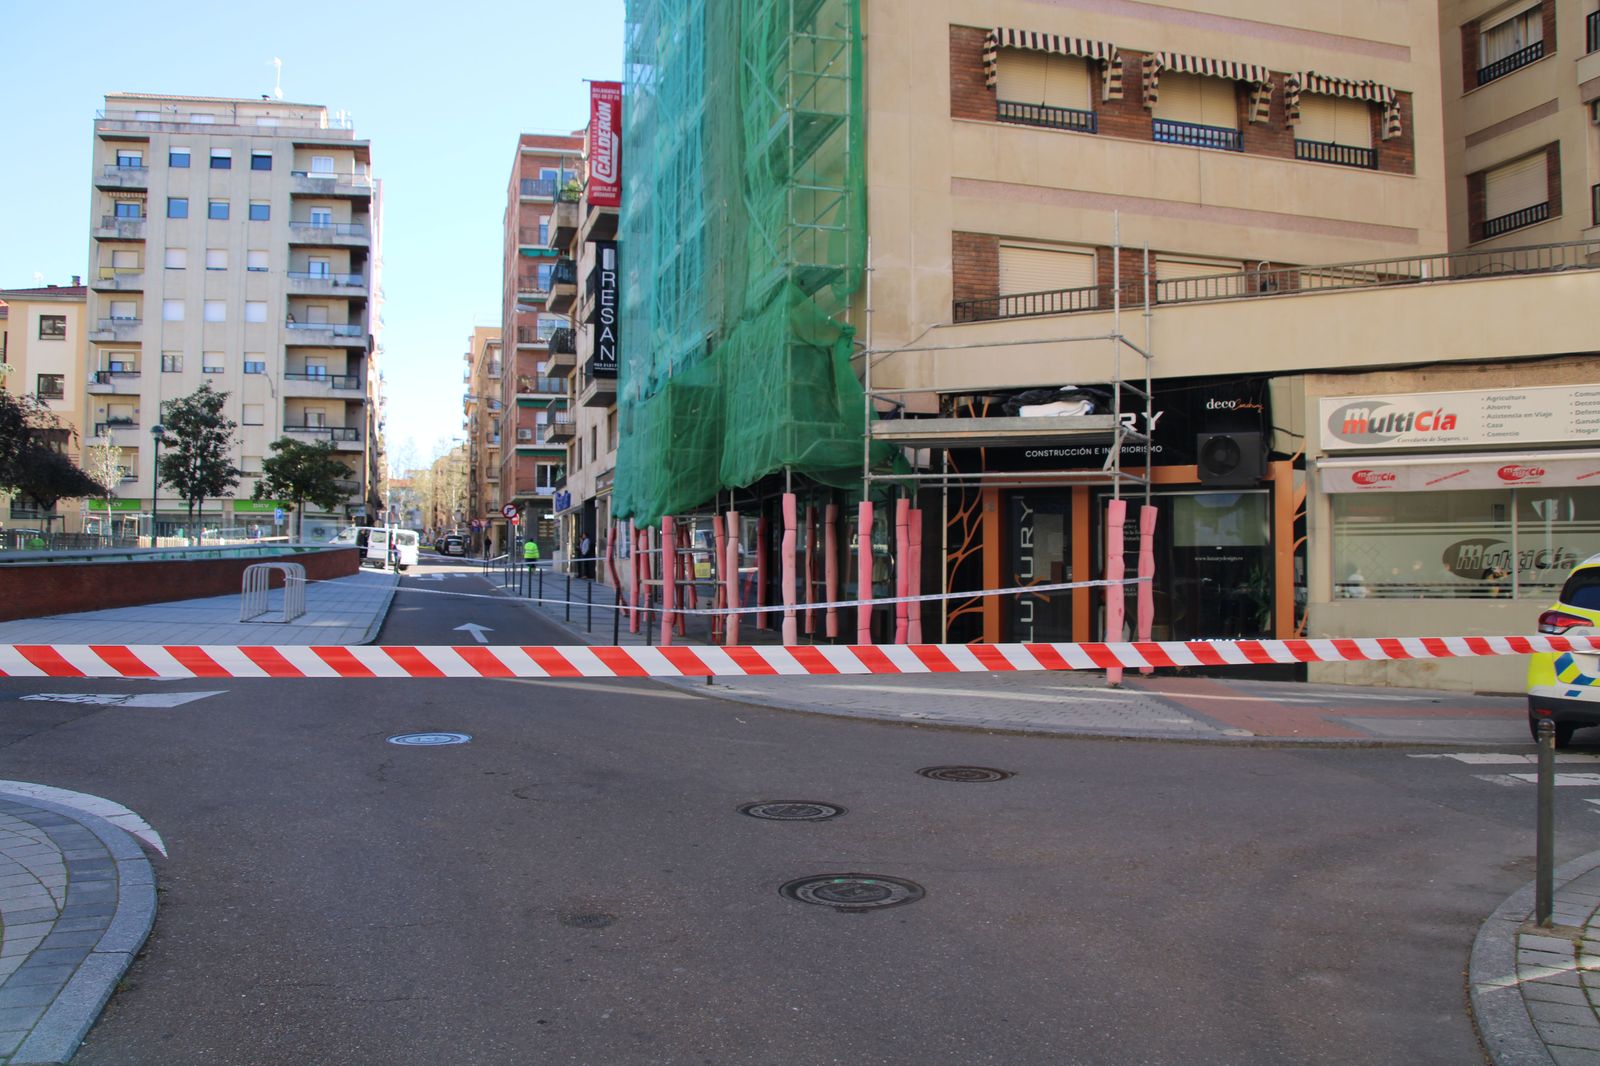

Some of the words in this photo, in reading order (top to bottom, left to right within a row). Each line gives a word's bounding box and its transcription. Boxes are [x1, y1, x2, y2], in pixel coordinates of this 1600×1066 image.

[596, 100, 611, 175] CALDERÓN
[600, 271, 616, 361] RESAN
[1206, 398, 1236, 410] deco
[1025, 447, 1092, 458] CONSTRUCCIÓN
[1094, 447, 1100, 455] E
